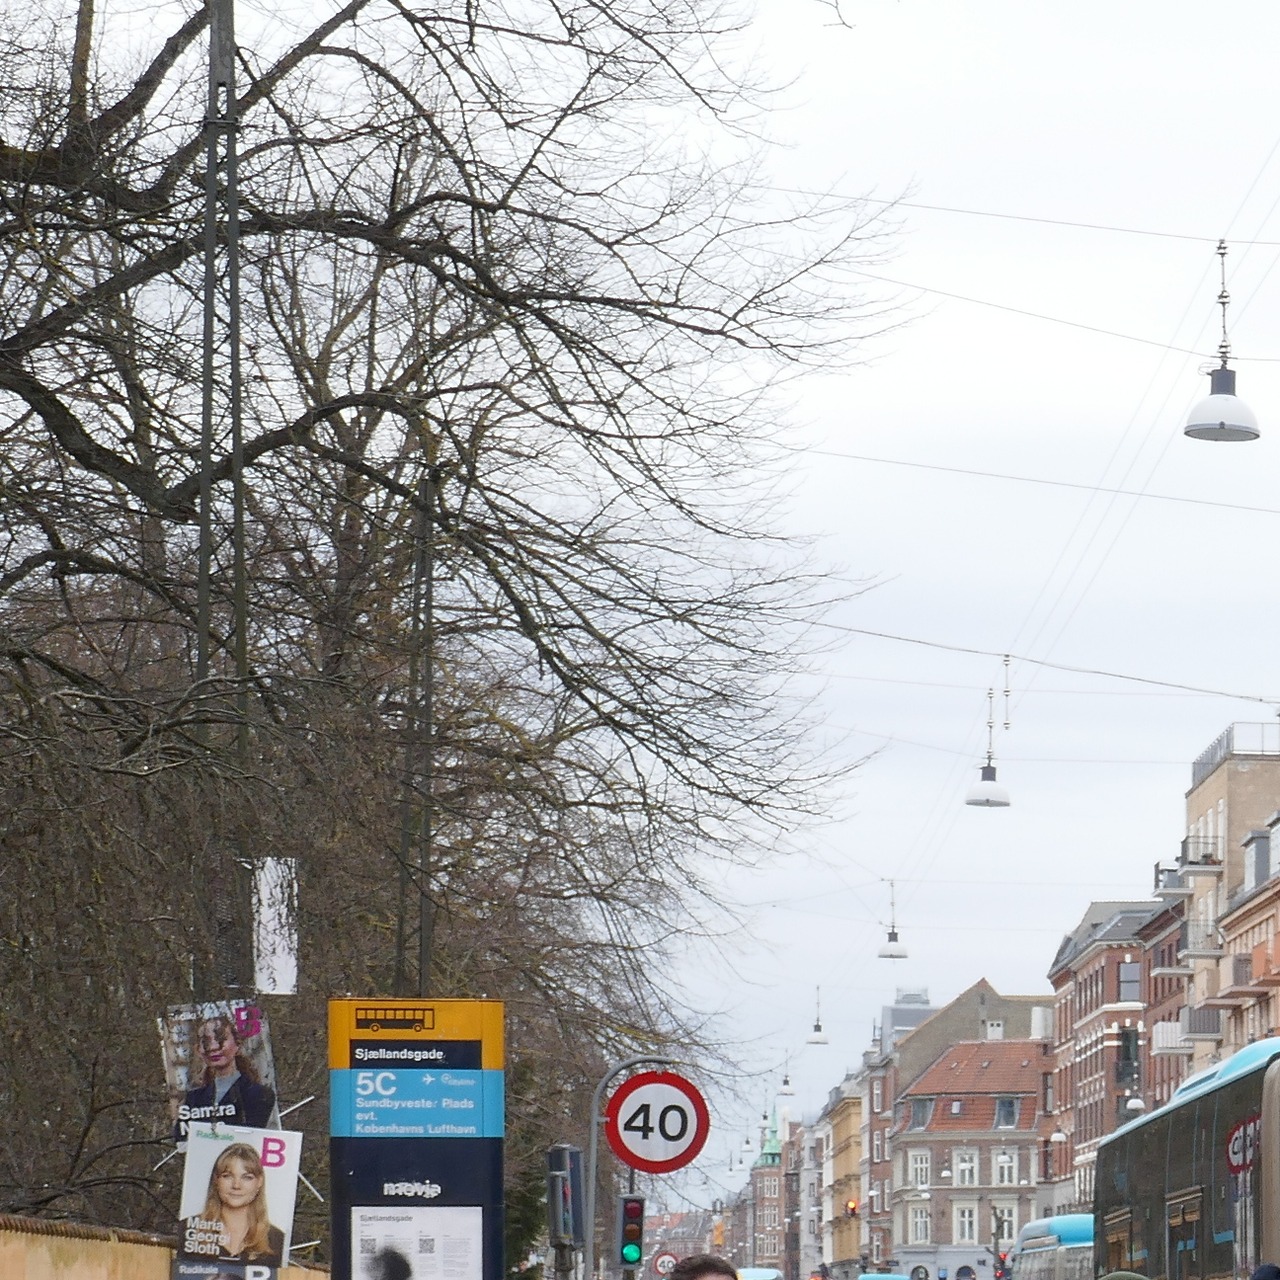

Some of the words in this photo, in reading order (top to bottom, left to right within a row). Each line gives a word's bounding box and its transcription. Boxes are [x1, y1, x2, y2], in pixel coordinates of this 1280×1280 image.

[235, 1006, 261, 1036] B
[355, 1048, 443, 1061] Sjællandsgade
[356, 1072, 397, 1096] 5C
[624, 1104, 688, 1142] 40
[260, 1137, 286, 1168] B
[187, 1217, 224, 1229] Maria
[184, 1241, 220, 1255] Sloth
[179, 1265, 219, 1274] Radikale
